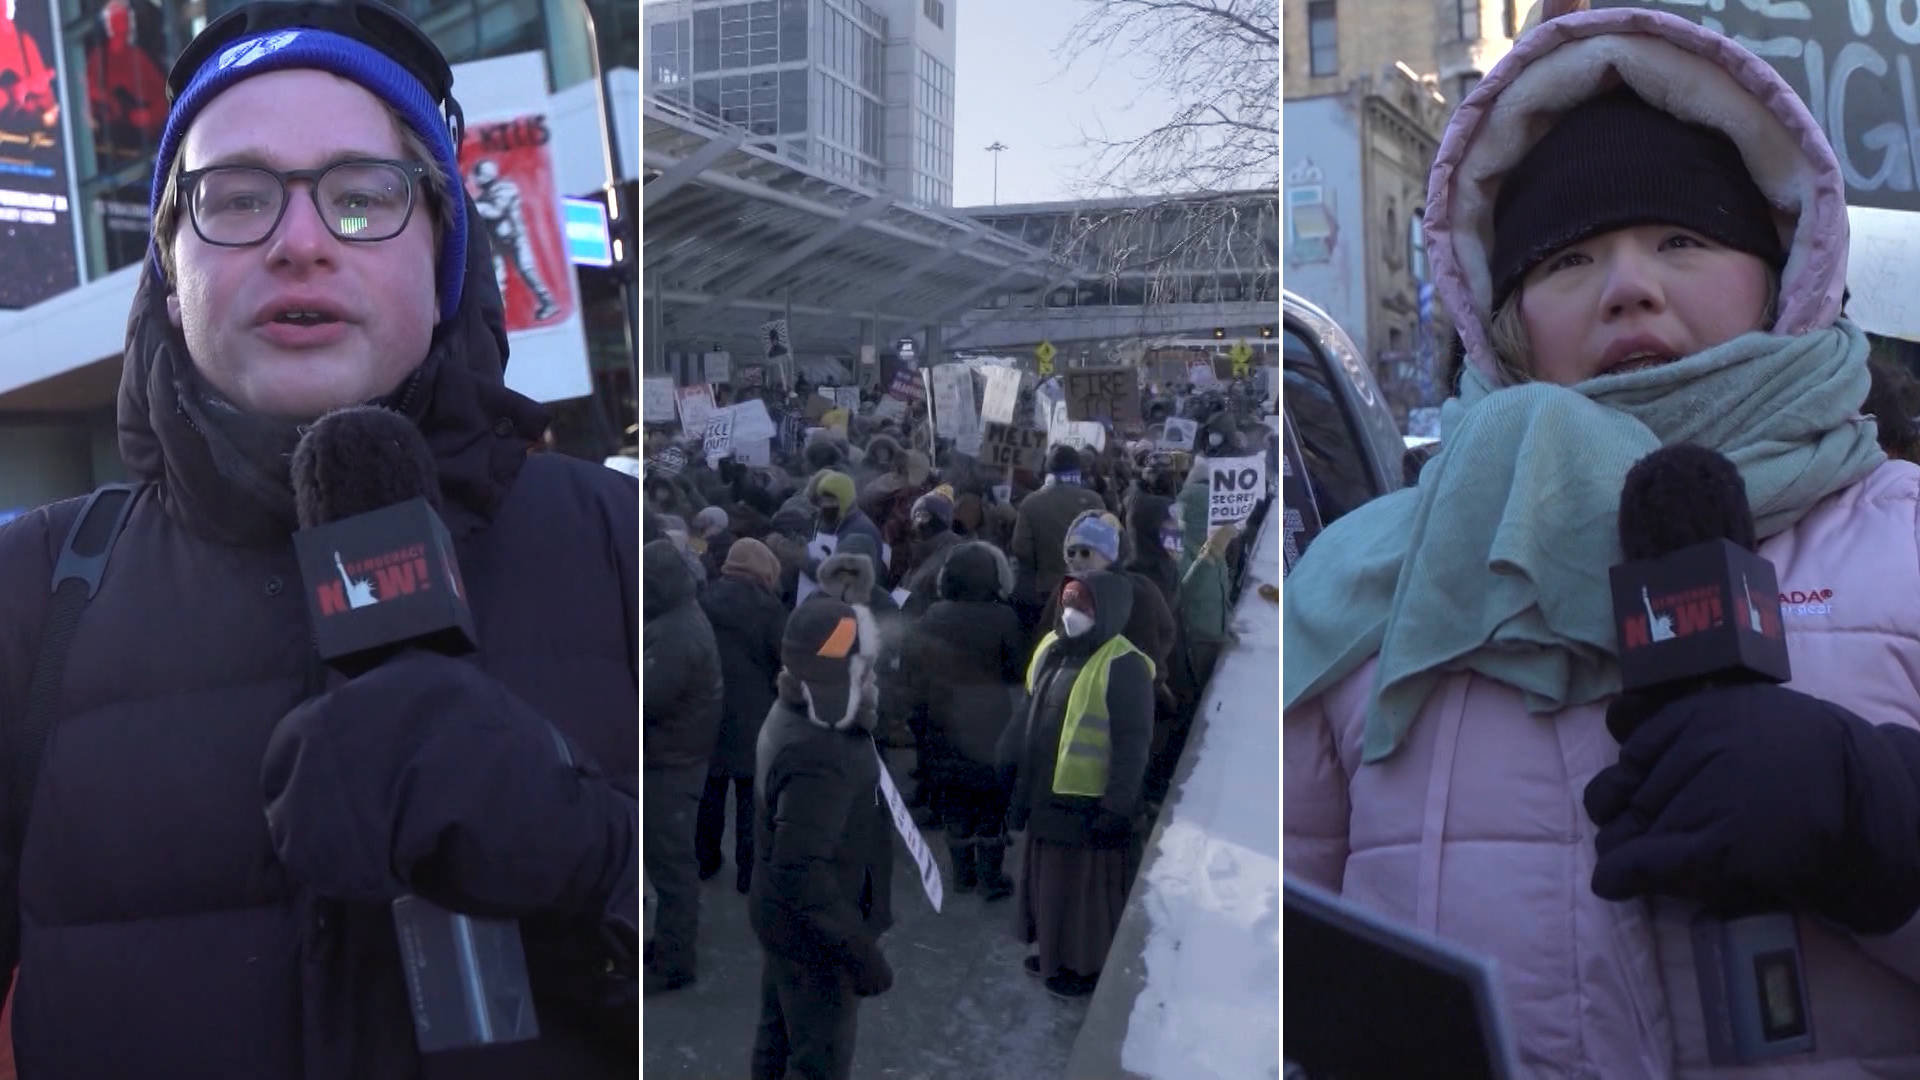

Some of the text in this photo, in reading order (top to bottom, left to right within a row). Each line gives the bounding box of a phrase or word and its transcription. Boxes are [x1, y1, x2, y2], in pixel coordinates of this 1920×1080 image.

[1070, 371, 1128, 397] FIRE
[708, 424, 729, 437] ICE
[993, 446, 1022, 465] ICE
[1214, 468, 1258, 492] NO
[1212, 494, 1255, 504] SECRET
[347, 543, 425, 573] DEMOCRACY
